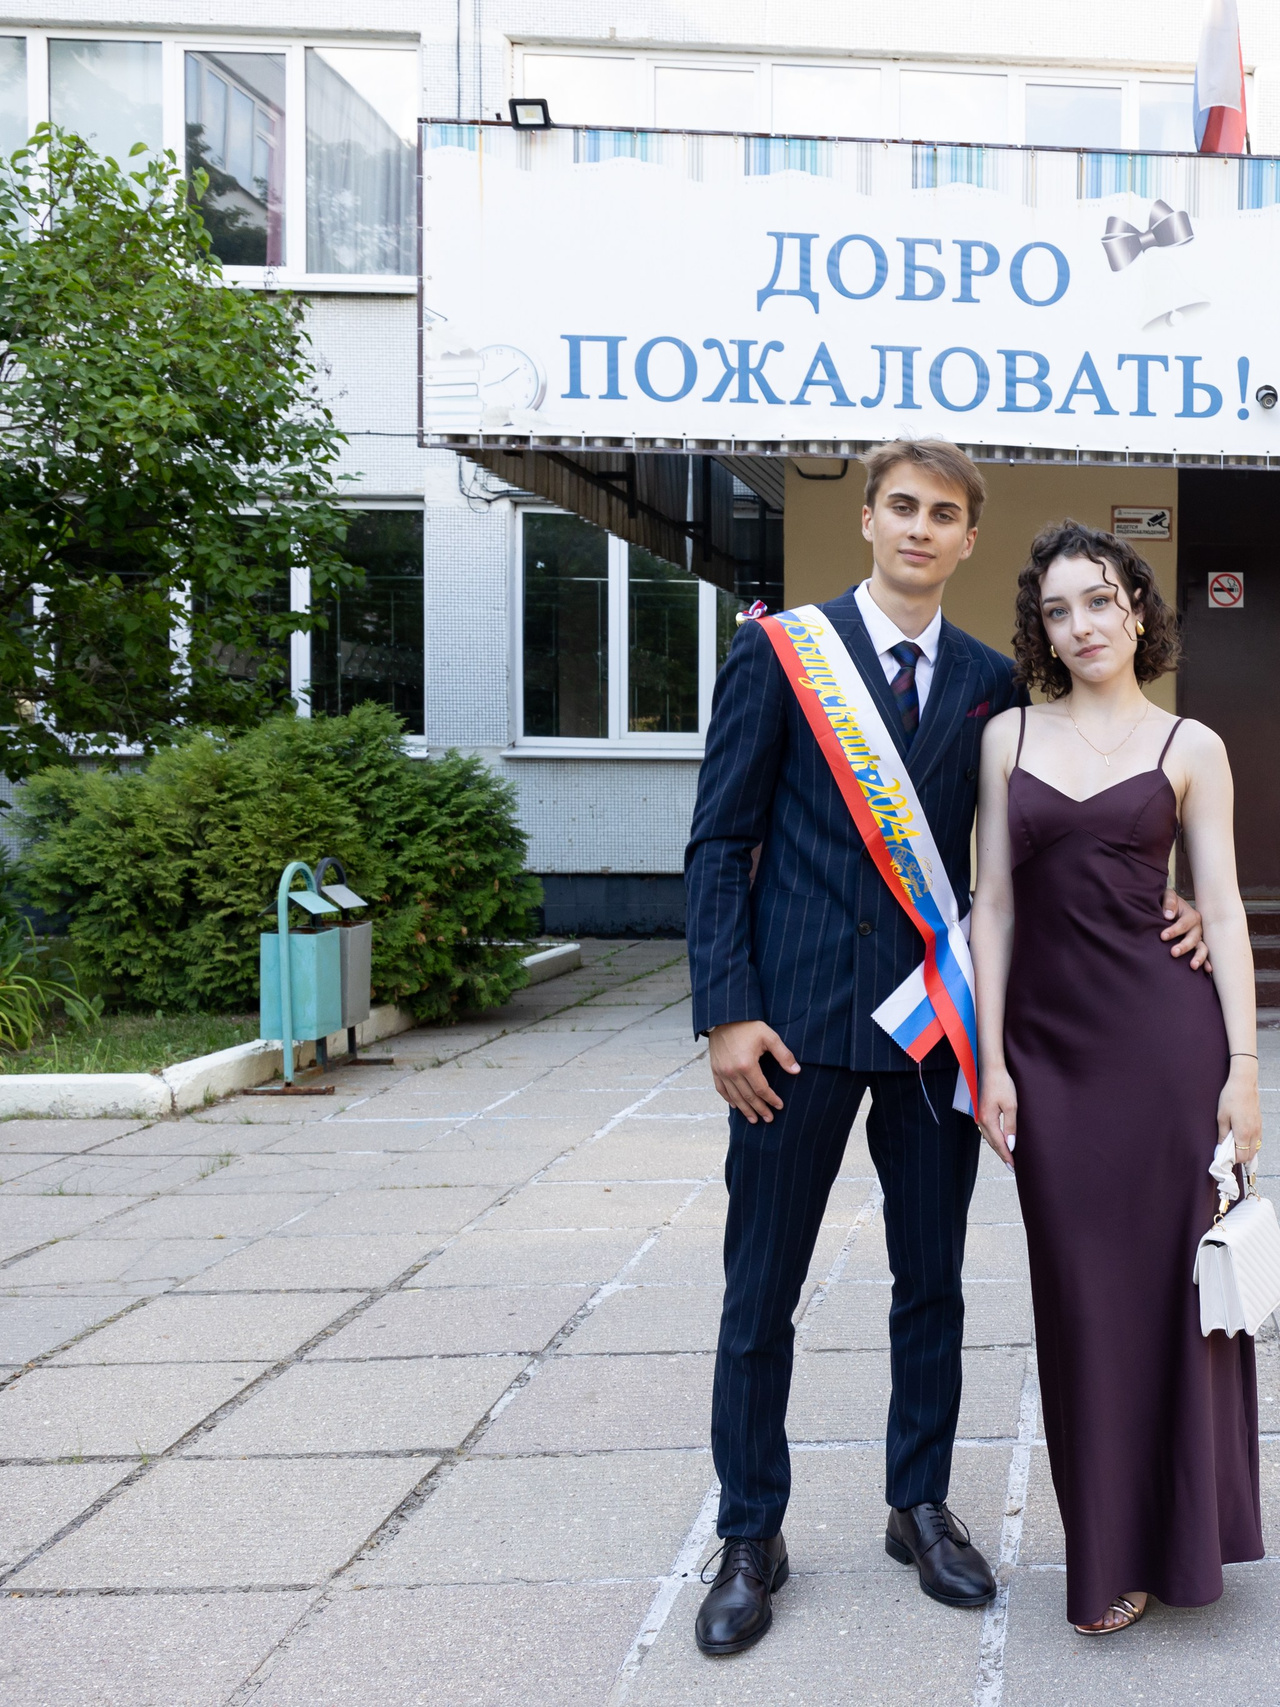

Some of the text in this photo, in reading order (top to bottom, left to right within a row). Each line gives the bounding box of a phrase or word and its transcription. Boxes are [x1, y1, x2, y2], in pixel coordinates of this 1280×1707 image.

[757, 231, 1071, 313] ДОБРО
[560, 333, 1252, 420] ПОЖАЛОВАТЬ!
[777, 614, 921, 844] Выпускник 2024
